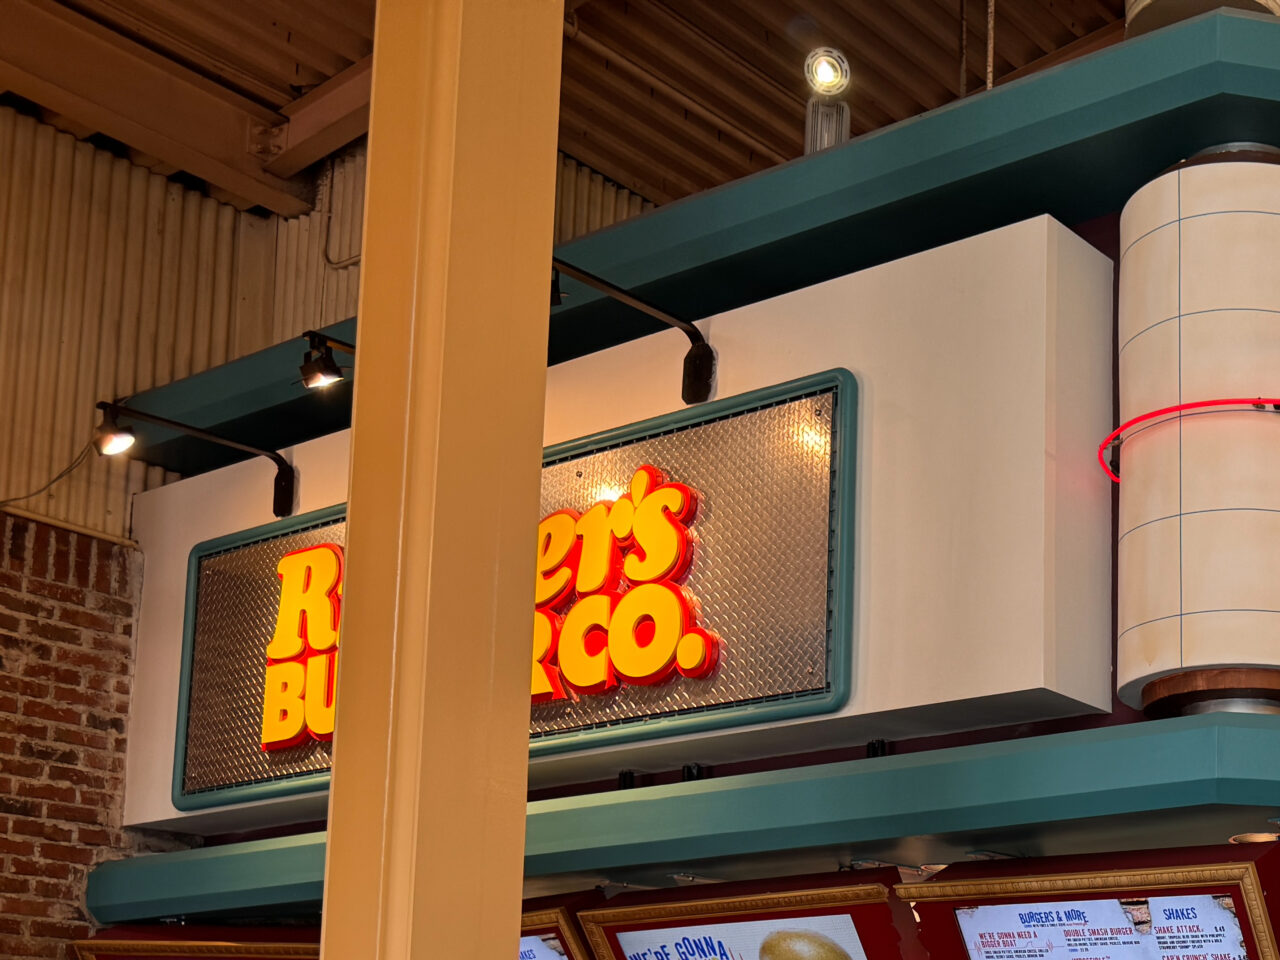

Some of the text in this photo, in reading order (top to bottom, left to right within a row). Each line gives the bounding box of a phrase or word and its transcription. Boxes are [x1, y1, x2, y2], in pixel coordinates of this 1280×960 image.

[1018, 909, 1088, 924] BURGERS & MORE
[1163, 907, 1197, 920] SHAKES
[1063, 927, 1133, 937] DOUBLE SMASH BURGER
[1154, 925, 1202, 934] SHAKE ATTACK
[1211, 953, 1232, 960] SHAKE
